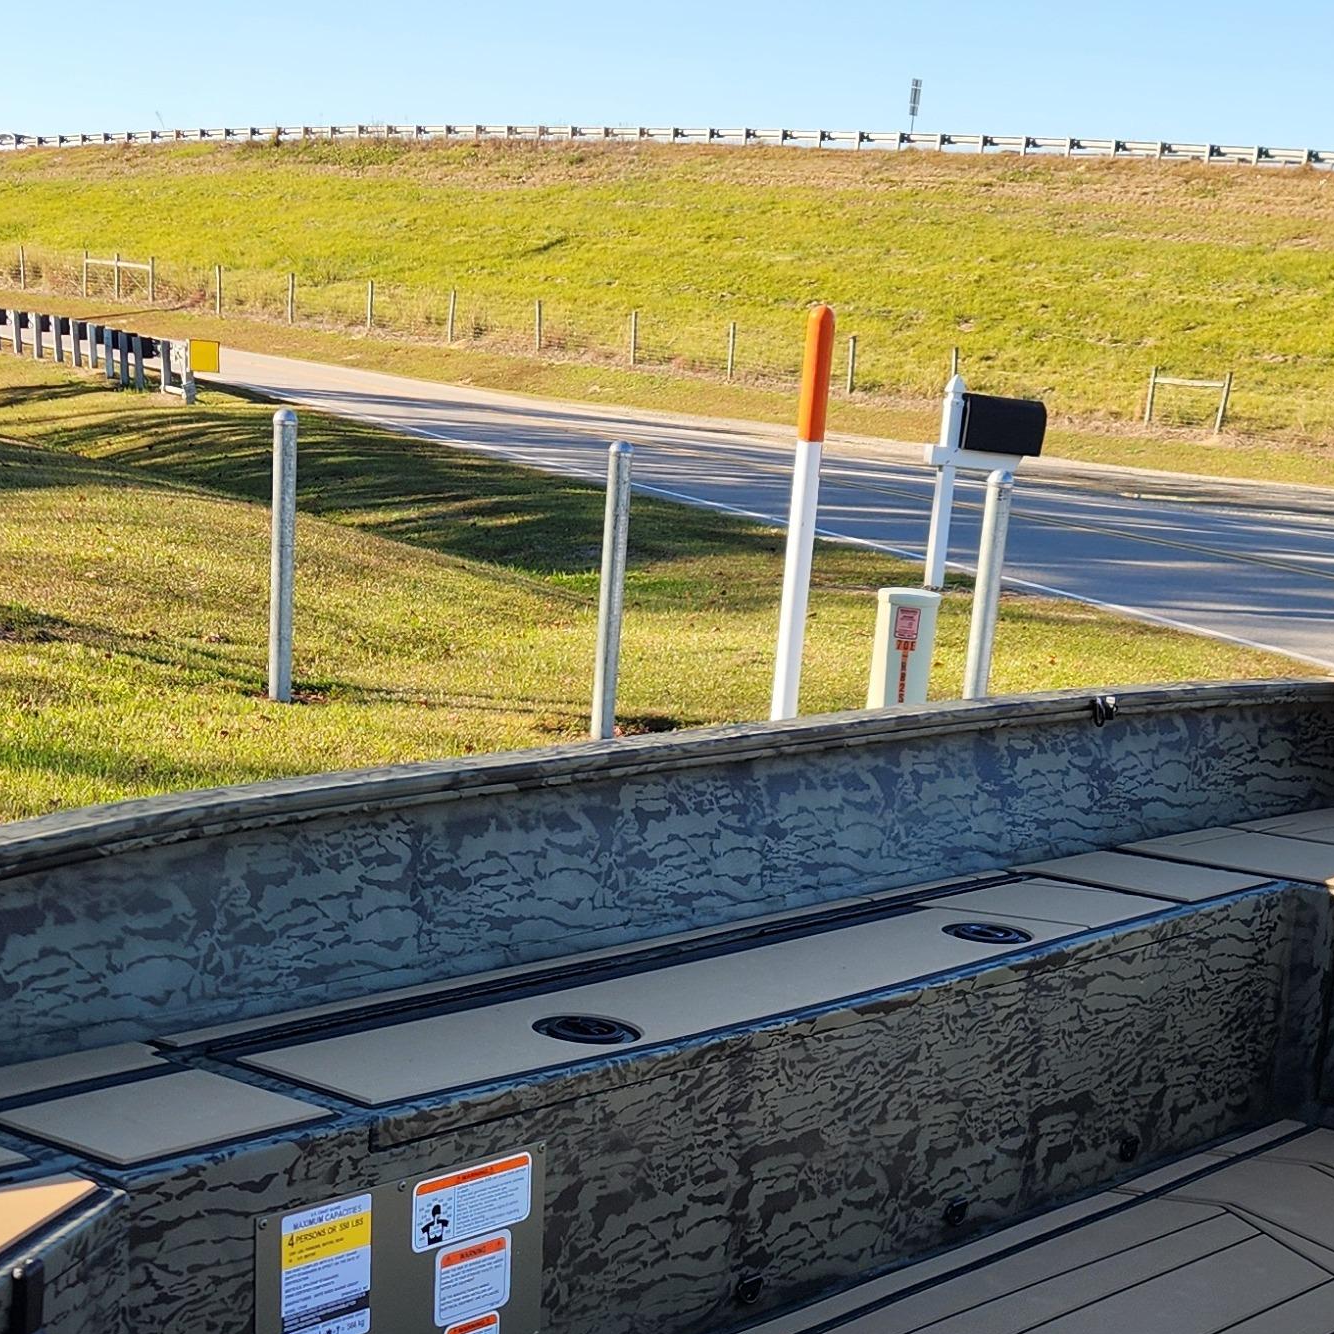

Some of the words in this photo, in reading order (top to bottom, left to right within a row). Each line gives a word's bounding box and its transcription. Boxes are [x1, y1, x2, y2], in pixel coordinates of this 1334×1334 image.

[293, 1215, 324, 1230] MAXIMUM
[324, 1205, 362, 1221] CAPACITIES
[288, 1234, 295, 1248] 4
[295, 1229, 327, 1244] PERSONS
[327, 1225, 337, 1235] OR
[351, 1217, 364, 1228] LBS
